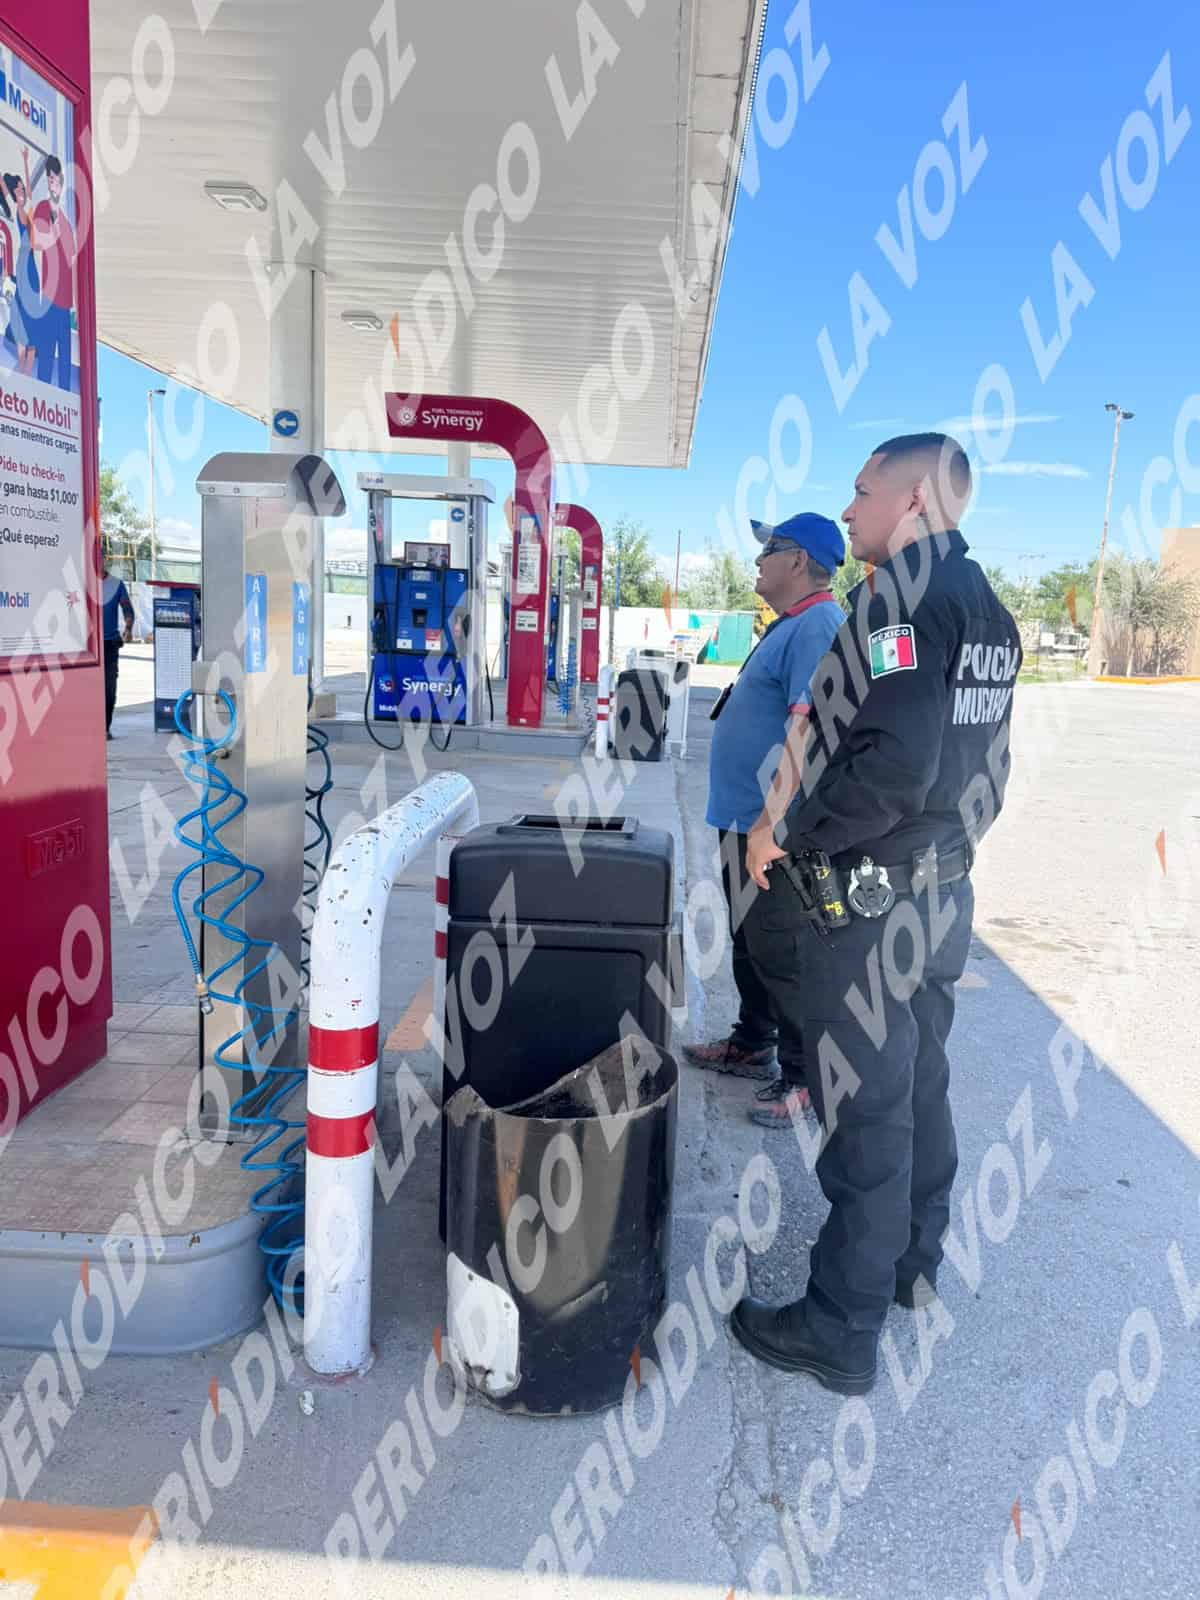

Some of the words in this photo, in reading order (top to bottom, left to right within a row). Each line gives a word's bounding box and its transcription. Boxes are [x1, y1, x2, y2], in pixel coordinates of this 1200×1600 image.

[8, 81, 47, 133] Mobil
[421, 410, 484, 432] Synergy
[21, 428, 53, 447] mientras
[20, 462, 29, 476] tu
[31, 463, 65, 482] check-in
[3, 483, 25, 497] gana
[27, 482, 49, 501] hasta
[24, 532, 60, 550] esperas?
[457, 572, 465, 583] 3
[0, 591, 30, 608] Mobil
[252, 578, 262, 667] AIRE
[296, 587, 306, 674] AGUA
[402, 677, 462, 697] Synergy
